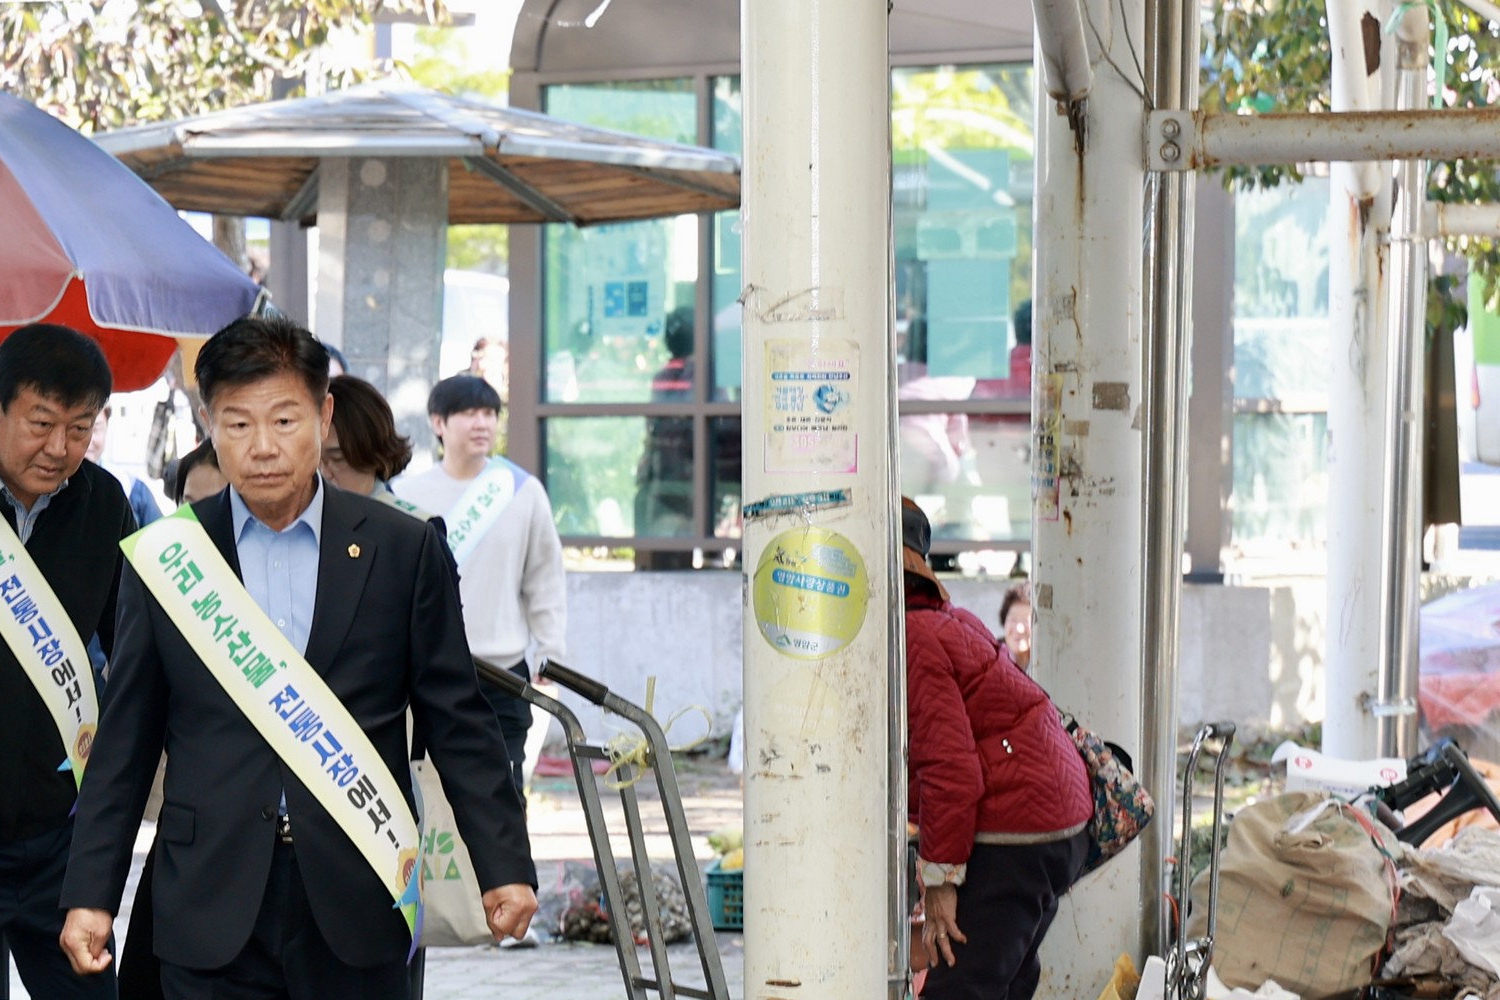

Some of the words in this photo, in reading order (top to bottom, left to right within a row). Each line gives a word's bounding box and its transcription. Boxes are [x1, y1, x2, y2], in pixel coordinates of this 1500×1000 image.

[159, 541, 204, 596] 우리
[191, 592, 288, 689] 농수산물,
[268, 683, 400, 849] 전통시장에서!
